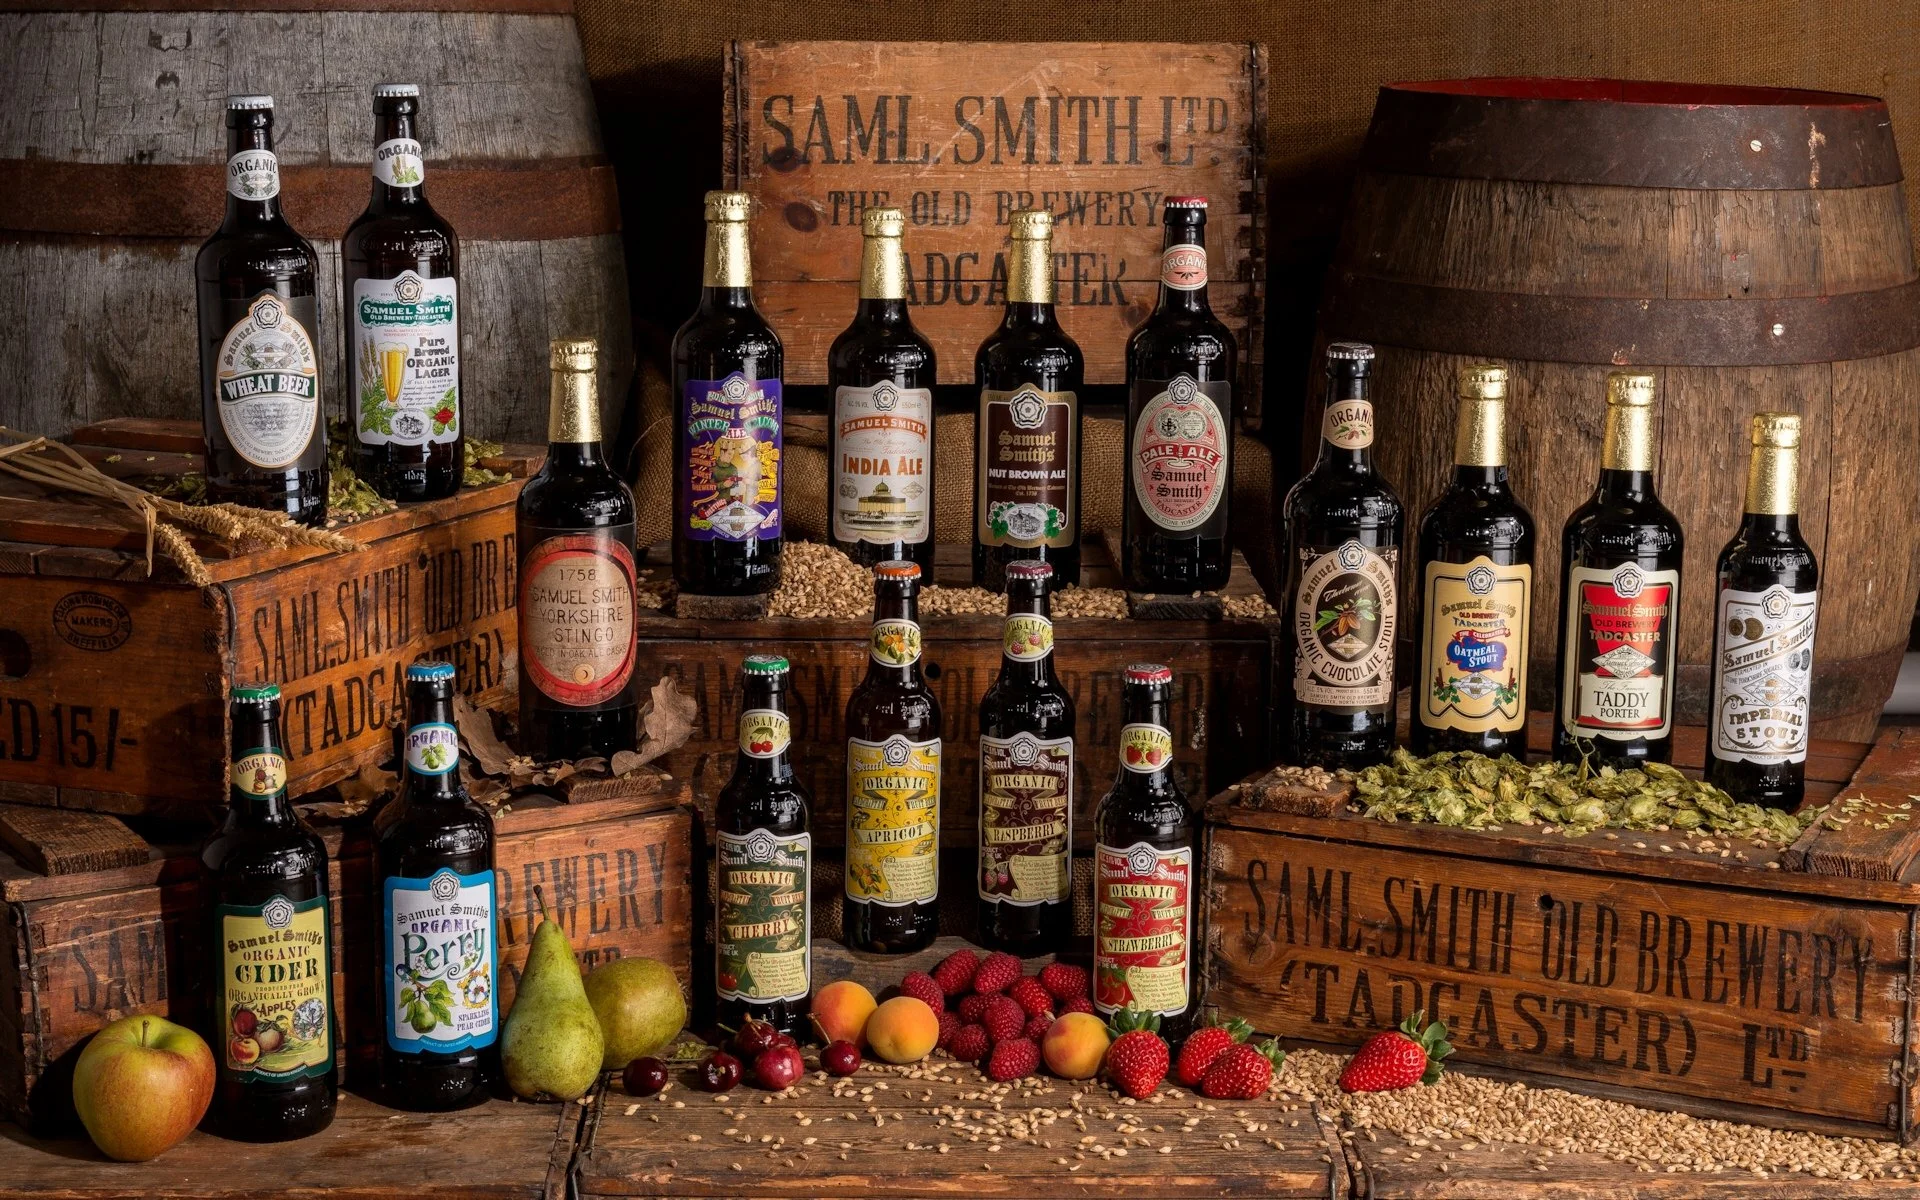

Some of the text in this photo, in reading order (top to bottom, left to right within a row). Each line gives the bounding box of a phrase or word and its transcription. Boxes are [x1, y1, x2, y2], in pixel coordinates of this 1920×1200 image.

[953, 95, 1142, 166] SMITH
[378, 143, 423, 161] ORGANIC
[231, 158, 277, 177] ORGANIC
[911, 191, 972, 226] OLD
[1162, 254, 1207, 273] ORGANIC
[364, 304, 450, 315] SAMUEL SMITH
[419, 337, 445, 347] Pure
[414, 346, 449, 357] Brewed
[407, 356, 455, 368] ORGANIC
[415, 368, 450, 379] LAGER
[224, 374, 310, 399] WHEAT BEER
[844, 419, 924, 433] SAMUEL SMITH
[1330, 408, 1373, 427] ORGANIC
[688, 418, 730, 437] WINTER
[726, 428, 748, 439] ALE
[998, 430, 1056, 447] Samuel
[1142, 445, 1216, 463] PALE ALE
[843, 454, 923, 476] INDIA ALE
[989, 468, 1066, 479] NUT BROWN ALE
[1151, 468, 1207, 482] Samuel
[1156, 483, 1202, 500] Smith
[1155, 500, 1203, 516] TADCASTER
[559, 569, 596, 581] 1758
[533, 586, 630, 604] SAMUEL SMITH
[336, 562, 410, 664] SMITH
[424, 549, 463, 636] OLD
[539, 606, 623, 624] YORKSHIRE
[71, 616, 114, 628] MAKERS
[1452, 616, 1505, 628] TADCASTER
[1616, 620, 1657, 628] BREWERY
[554, 627, 614, 643] STINGO
[1589, 629, 1661, 642] TADCASTER
[1300, 612, 1394, 681] ORGANIC CHOCOLATE STOUT
[1454, 644, 1497, 657] OATMEAL
[1469, 653, 1498, 668] STOUT
[1594, 691, 1649, 708] TADDY
[1600, 708, 1640, 718] PORTER
[1729, 708, 1803, 726] IMPERIAL
[742, 716, 785, 728] ORGANIC
[407, 729, 459, 751] ORGANIC
[1736, 727, 1798, 740] STOUT
[237, 756, 284, 776] ORGANIC
[867, 778, 927, 789] ORGANIC
[995, 776, 1056, 788] ORGANIC
[866, 824, 925, 843] APRICOT
[994, 821, 1056, 842] RASPBERRY
[732, 872, 792, 884] ORGANIC
[497, 841, 667, 945] REWERY
[1112, 885, 1173, 898] ORGANIC
[397, 904, 445, 925] Samuel
[411, 919, 478, 934] ORGANIC
[732, 918, 791, 938] CHERRY
[228, 930, 280, 953] Samuel
[1108, 932, 1174, 952] STRAWBERRY
[1380, 876, 1516, 977] SMITH
[1540, 895, 1621, 990] OLD
[1638, 910, 1874, 1024] BREWERY
[243, 945, 310, 962] ORGANIC
[396, 928, 486, 981] Perry
[235, 958, 318, 984] CIDER
[228, 979, 325, 1002] ORGANICALLY GROWN
[458, 1009, 489, 1022] SPARKLING
[457, 1018, 490, 1031] PEAR CIDER
